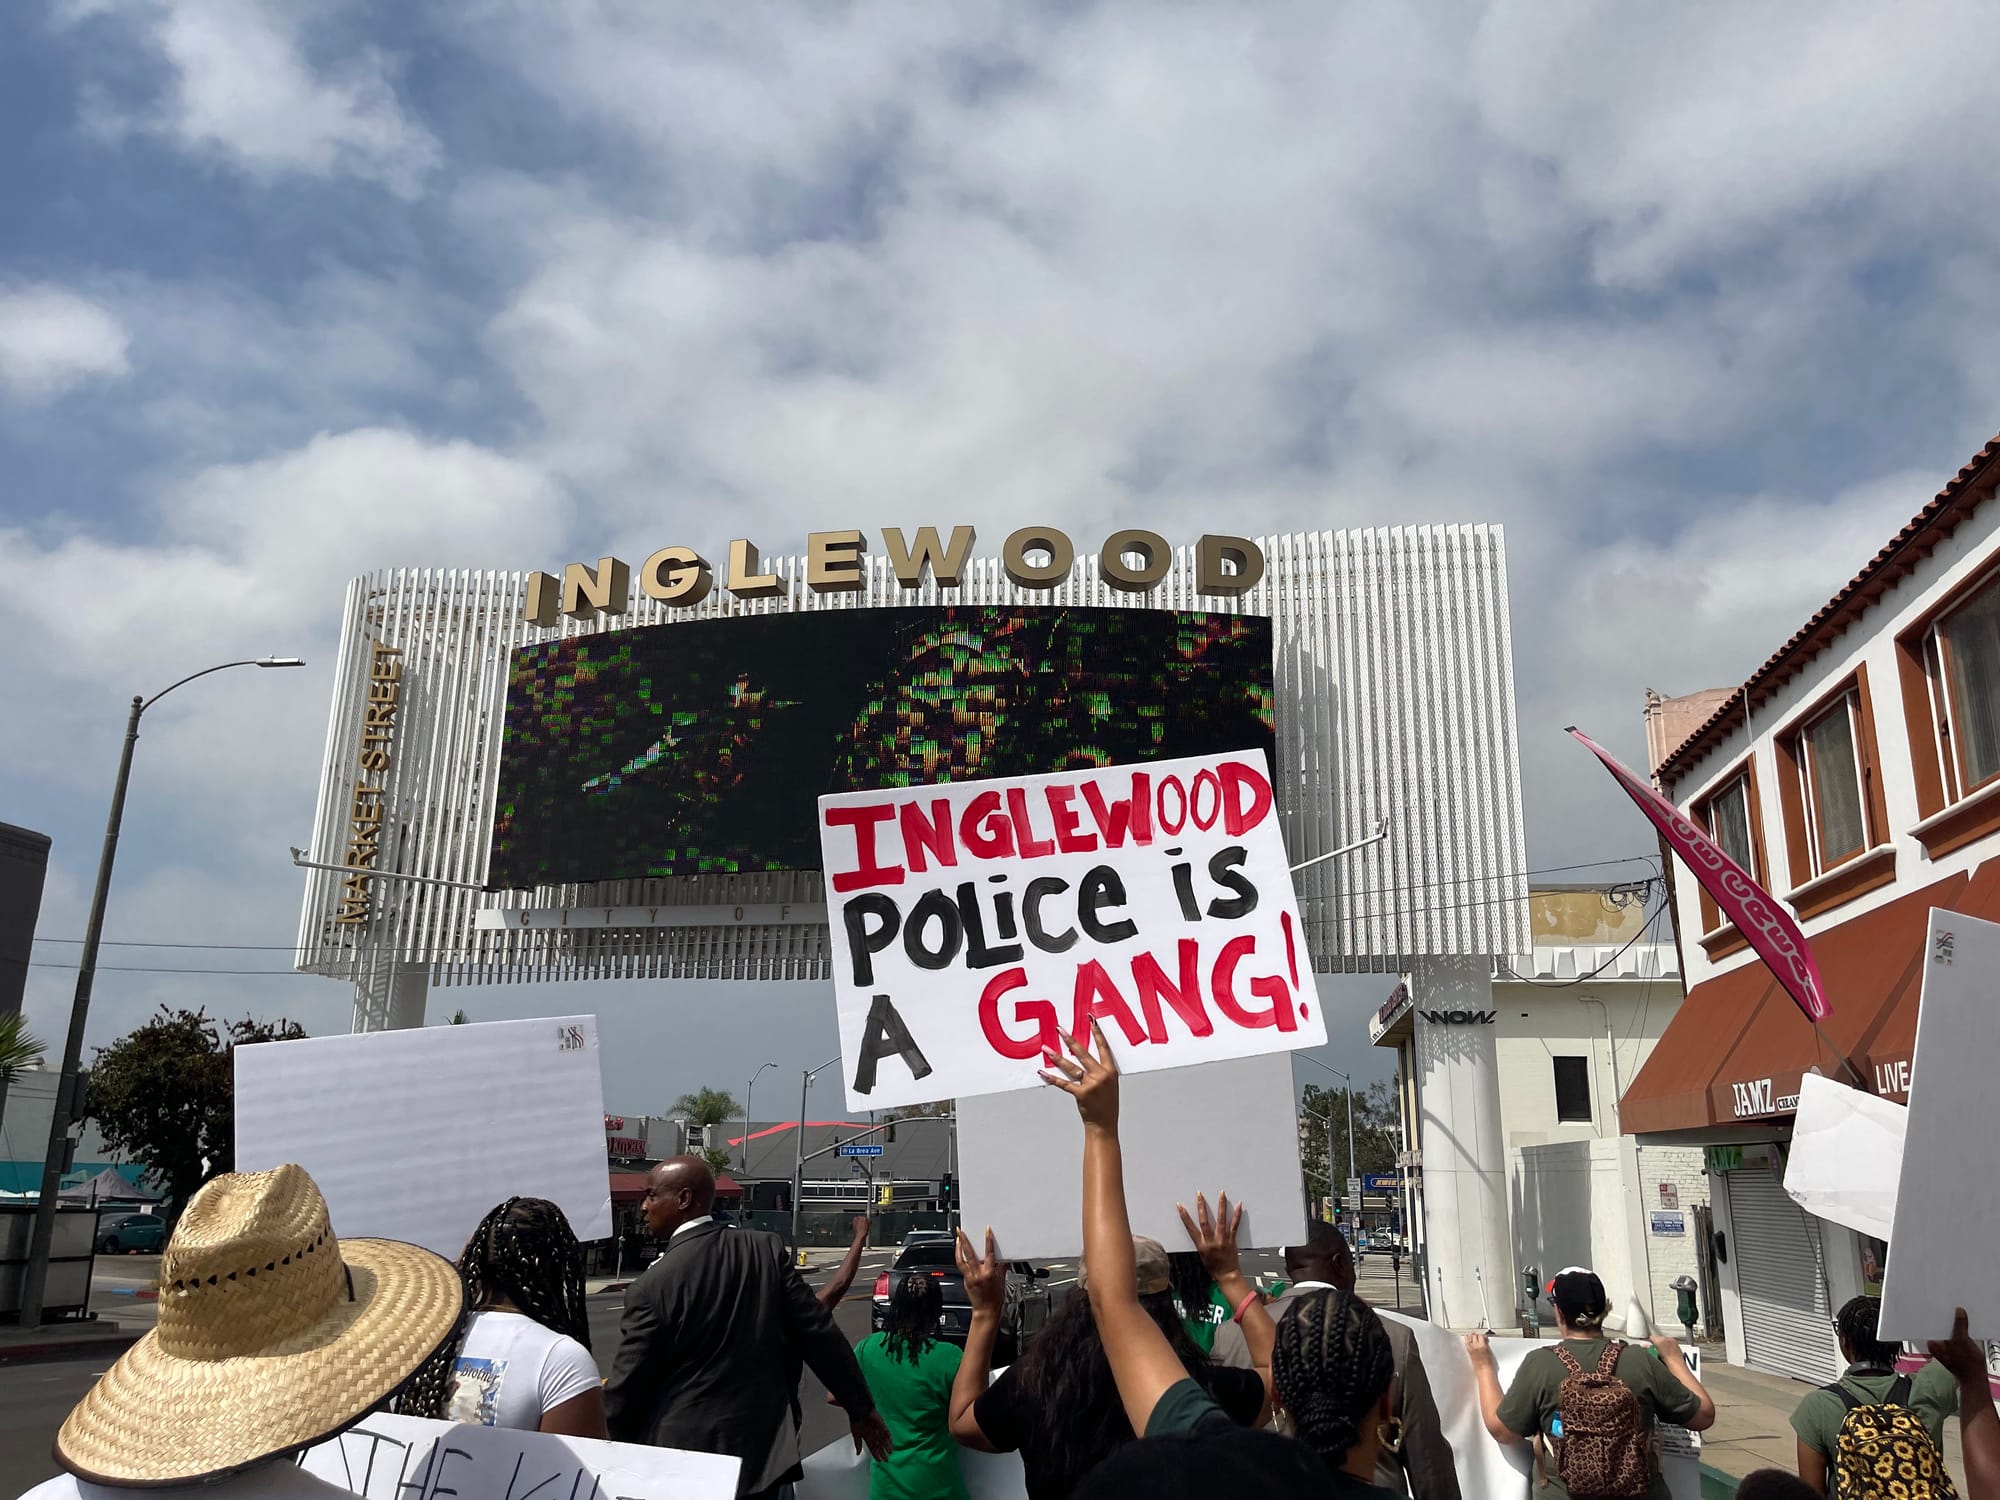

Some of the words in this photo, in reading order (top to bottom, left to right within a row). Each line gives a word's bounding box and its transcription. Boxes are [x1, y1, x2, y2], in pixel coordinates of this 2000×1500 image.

[525, 525, 1264, 627] INGLEWOOD
[336, 780, 384, 924] MARKET
[360, 640, 402, 772] STREET
[825, 762, 1272, 892] INGLEWOOD
[520, 907, 659, 926] CITY
[734, 904, 791, 922] OF
[853, 994, 933, 1095] A
[978, 911, 1311, 1068] GANG!
[1732, 1078, 1776, 1118] JAMZ
[1875, 1061, 1909, 1094] LIVE
